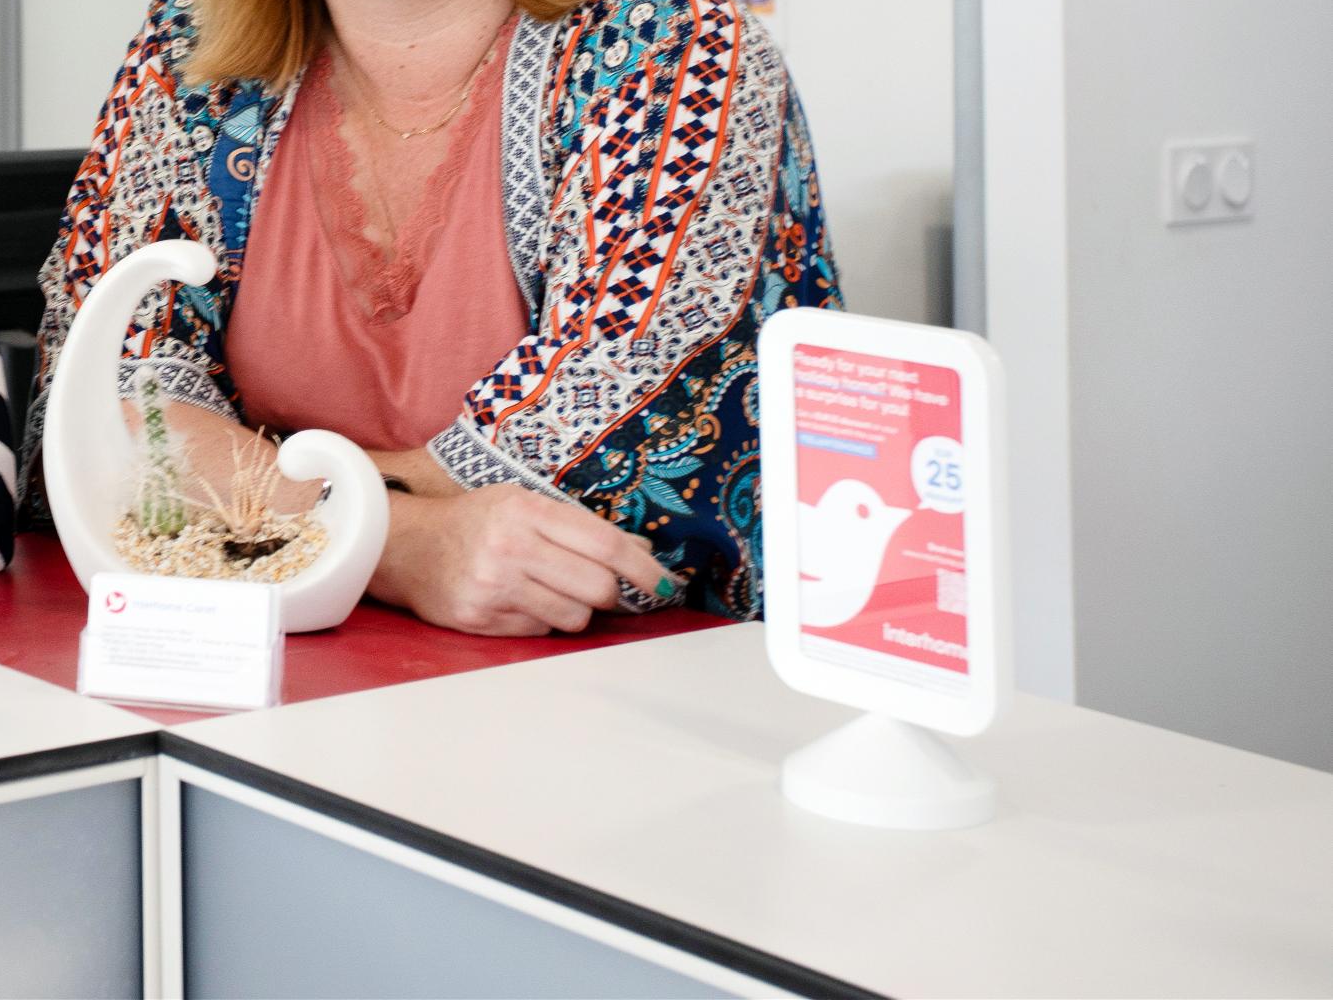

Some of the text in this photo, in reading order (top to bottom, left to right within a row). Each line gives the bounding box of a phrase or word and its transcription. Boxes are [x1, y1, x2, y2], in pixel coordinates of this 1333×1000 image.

[836, 358, 856, 374] for
[857, 364, 887, 381] your
[859, 395, 879, 411] for
[926, 459, 963, 491] 25
